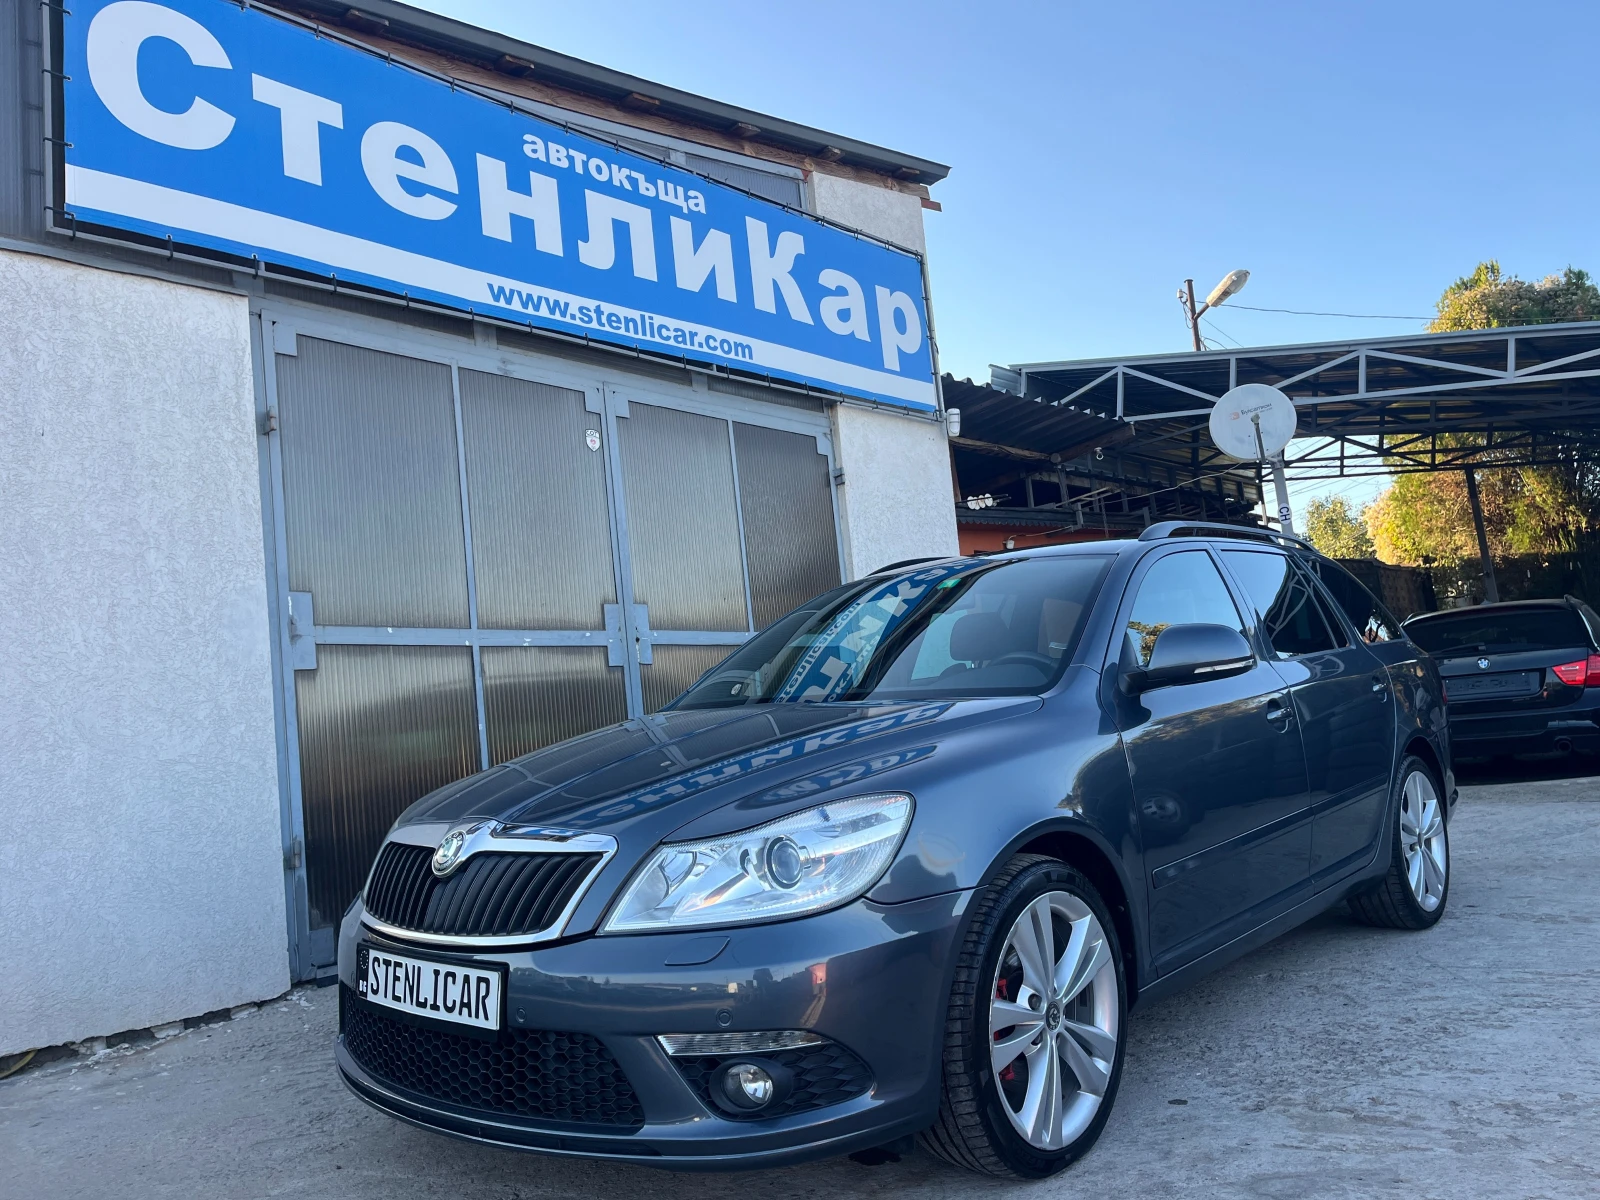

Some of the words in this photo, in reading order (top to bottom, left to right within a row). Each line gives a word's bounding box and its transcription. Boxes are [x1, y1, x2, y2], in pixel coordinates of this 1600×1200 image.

[86, 0, 921, 372] СтенлиКар
[522, 133, 707, 215] автокъща
[486, 282, 754, 361] www.stenlicar.com
[371, 956, 491, 1021] STENLICAR
